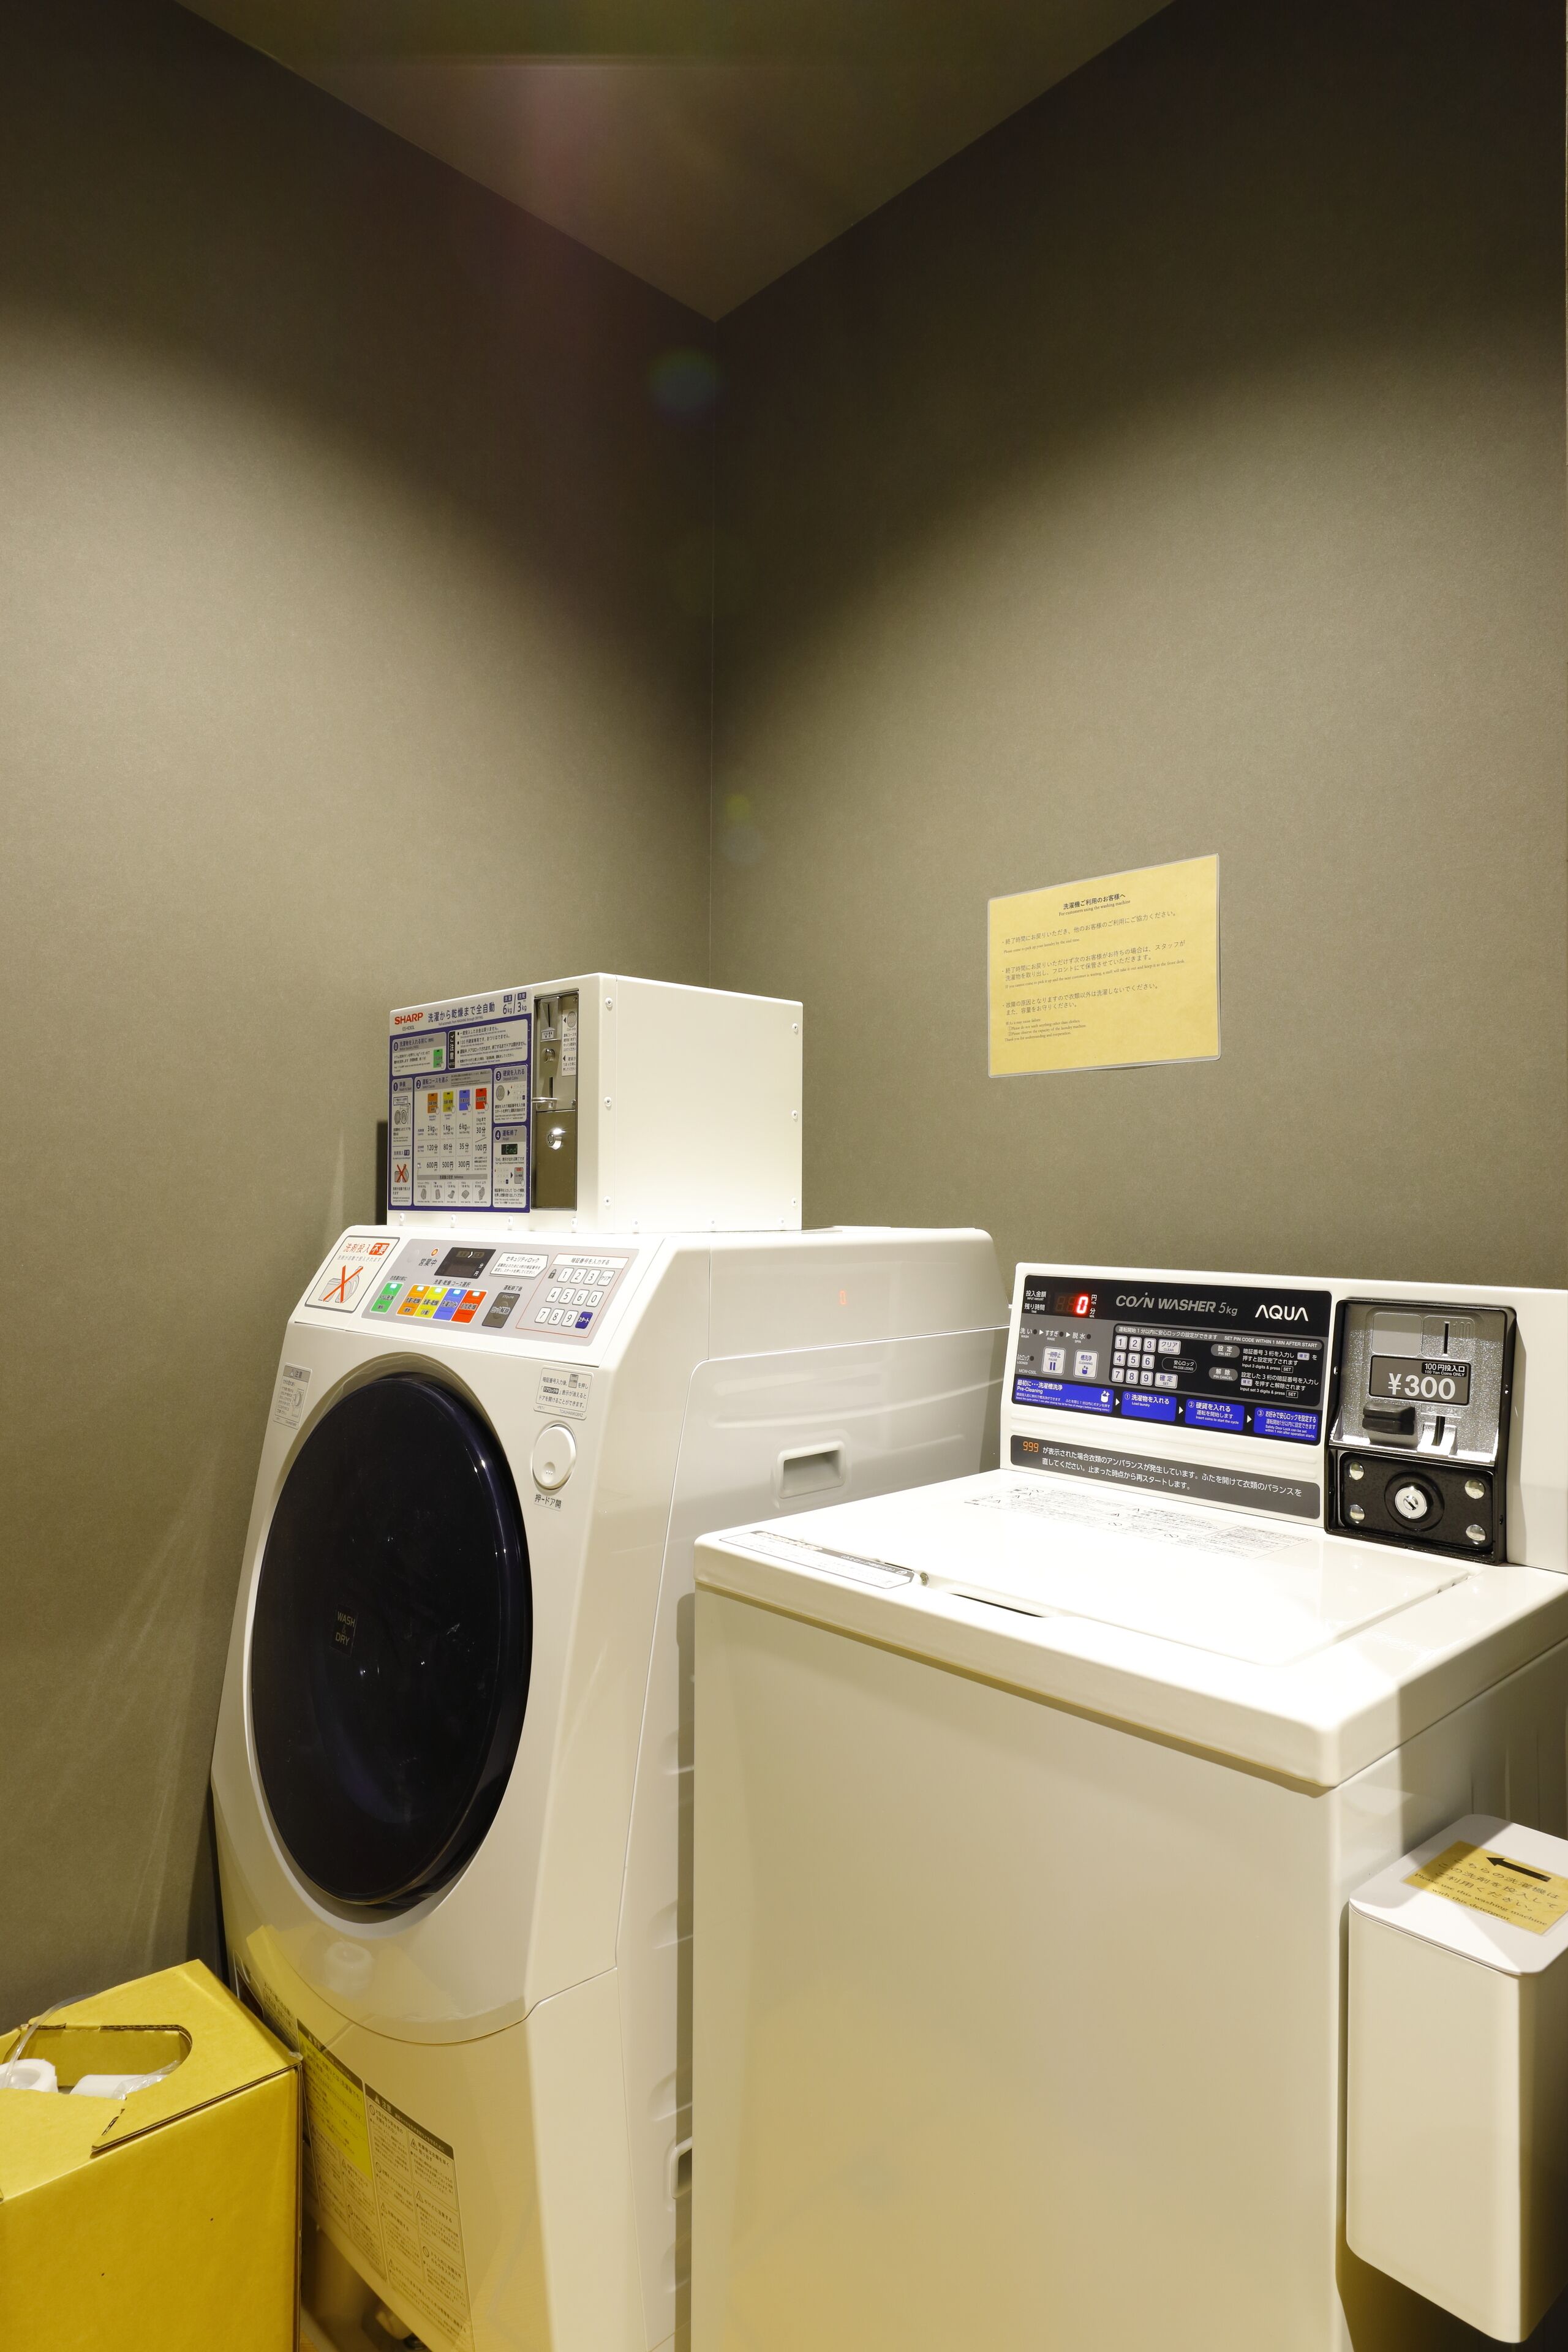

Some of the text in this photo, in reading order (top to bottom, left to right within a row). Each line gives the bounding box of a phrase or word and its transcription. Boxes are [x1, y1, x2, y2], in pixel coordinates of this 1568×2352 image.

[1063, 893, 1126, 910] 洗濯機ご利用のお客様へ
[394, 1012, 424, 1025] SHARP
[428, 1002, 495, 1022] 洗濯から乾燥まで全自動
[418, 1258, 438, 1267] 営業中
[1076, 1295, 1089, 1314] 0
[1158, 1298, 1216, 1313] WASHER
[1255, 1305, 1309, 1322] AQUA
[1242, 1355, 1298, 1366] 押すと設定完了されます
[1017, 1386, 1043, 1395] Pre-Cleaning
[1388, 1373, 1456, 1400] ¥300
[1131, 1393, 1169, 1405] 洗濯物を入れる
[1196, 1401, 1231, 1412] 硬貨を入れる
[1196, 1409, 1233, 1420] 運転を開始します
[1265, 1411, 1316, 1423] お好みで安心ロックを設定する
[1023, 1441, 1039, 1452] 999
[1042, 1458, 1190, 1490] 直してください。止まった時点から再スタートします。
[337, 1611, 355, 1627] WASH
[335, 1632, 350, 1646] DRY
[1438, 1863, 1559, 1909] この洗剤を投入して
[1414, 1872, 1439, 1884] Please
[1475, 1896, 1509, 1912] washing
[1511, 1910, 1547, 1926] machine
